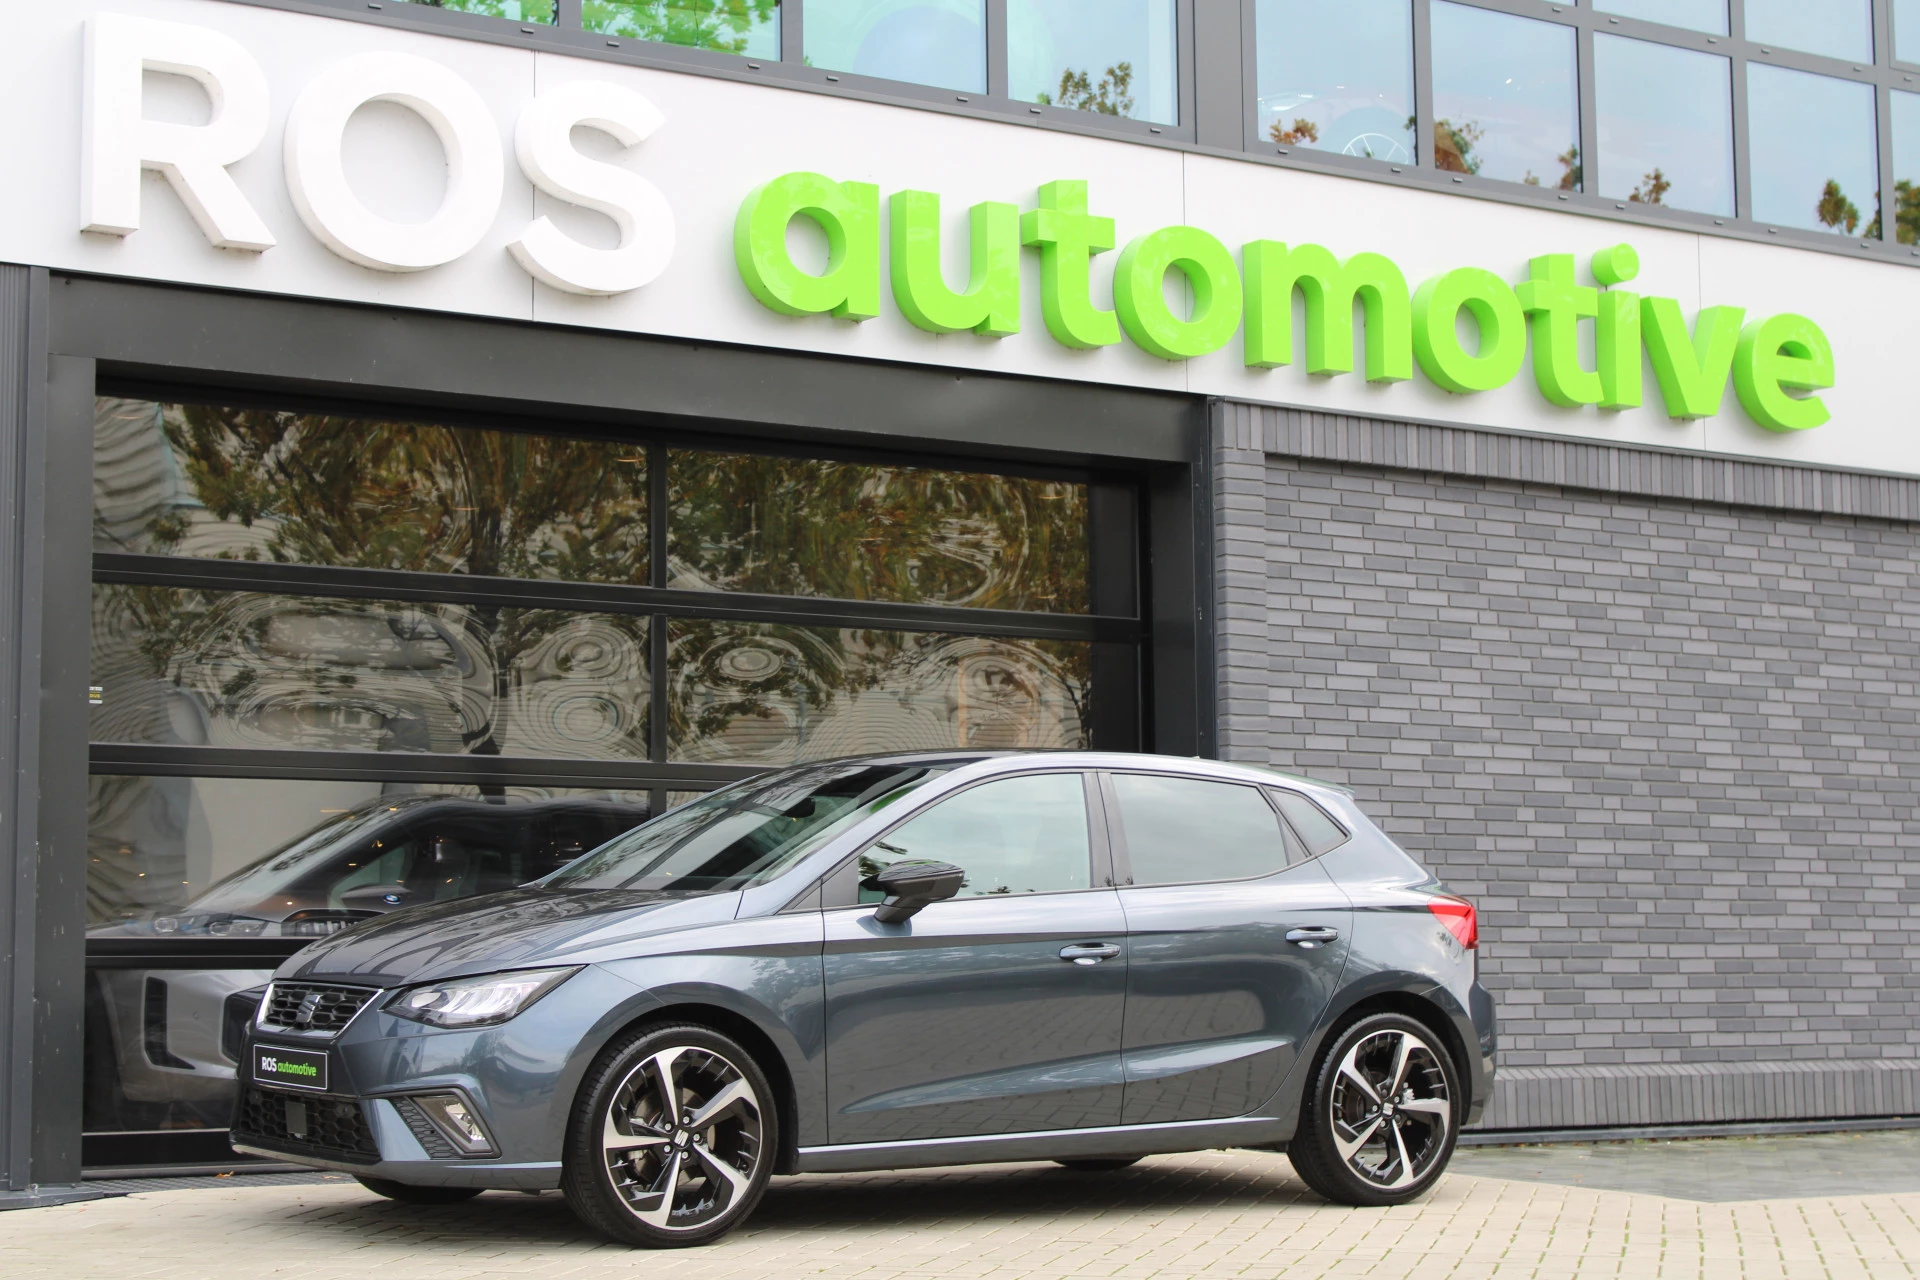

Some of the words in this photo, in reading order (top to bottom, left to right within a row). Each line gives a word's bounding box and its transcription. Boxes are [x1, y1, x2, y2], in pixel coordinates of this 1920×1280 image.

[80, 15, 676, 296] ROS
[733, 171, 1835, 433] automotive
[261, 1056, 277, 1072] ROS
[277, 1061, 317, 1076] automotive
